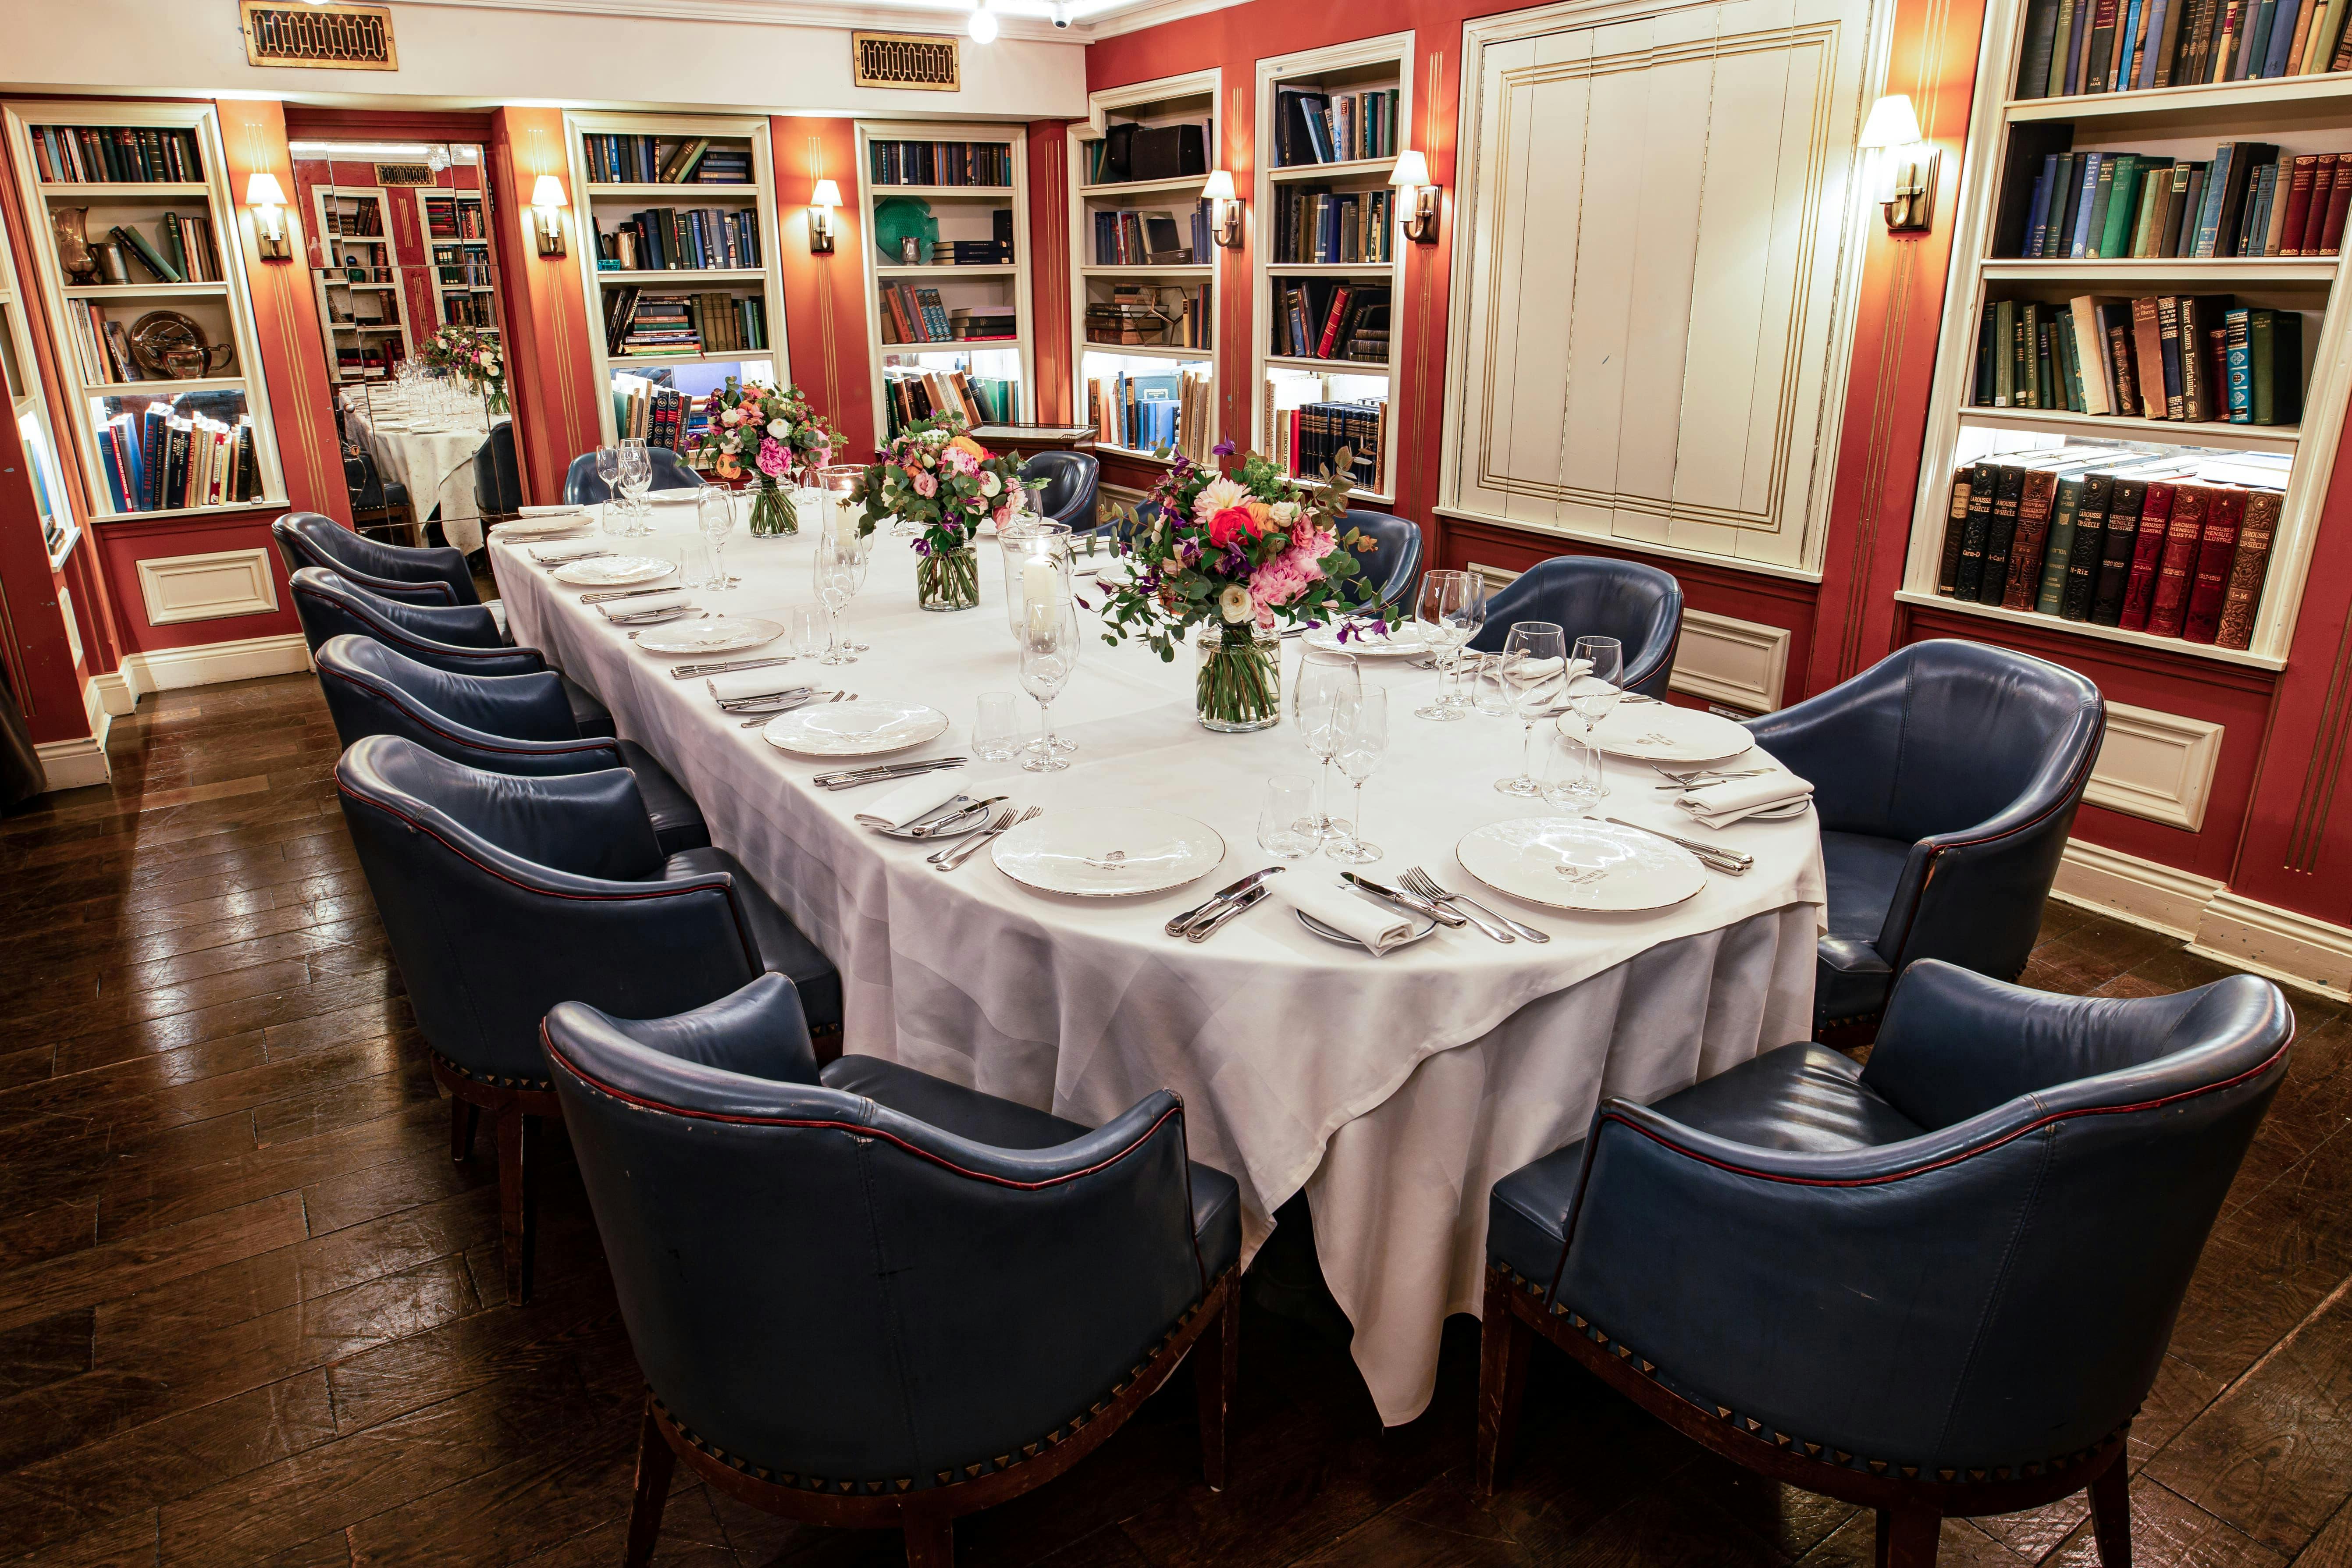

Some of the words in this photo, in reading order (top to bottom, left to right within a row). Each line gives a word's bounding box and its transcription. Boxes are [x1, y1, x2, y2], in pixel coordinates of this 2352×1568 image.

[2182, 300, 2192, 326] ROBERT
[2184, 324, 2193, 350] CARRIER
[2185, 352, 2196, 397] Entertaining
[144, 456, 153, 490] PAINTING
[2079, 511, 2103, 519] LAROUSSE
[2171, 521, 2199, 530] LAROUSSE
[2206, 525, 2235, 533] LAROUSSE
[2169, 531, 2197, 539] ILLUSTRÉ
[2205, 530, 2234, 538] MENSUEL
[2242, 530, 2269, 540] LAROUSSE
[2203, 535, 2231, 544] ILLUSTRÉ
[2070, 567, 2089, 576] N-Riz
[2199, 573, 2221, 581] 1917-1919
[1085, 857, 1126, 869] BELEY'S
[1569, 869, 1604, 884] BENTLEY'S
